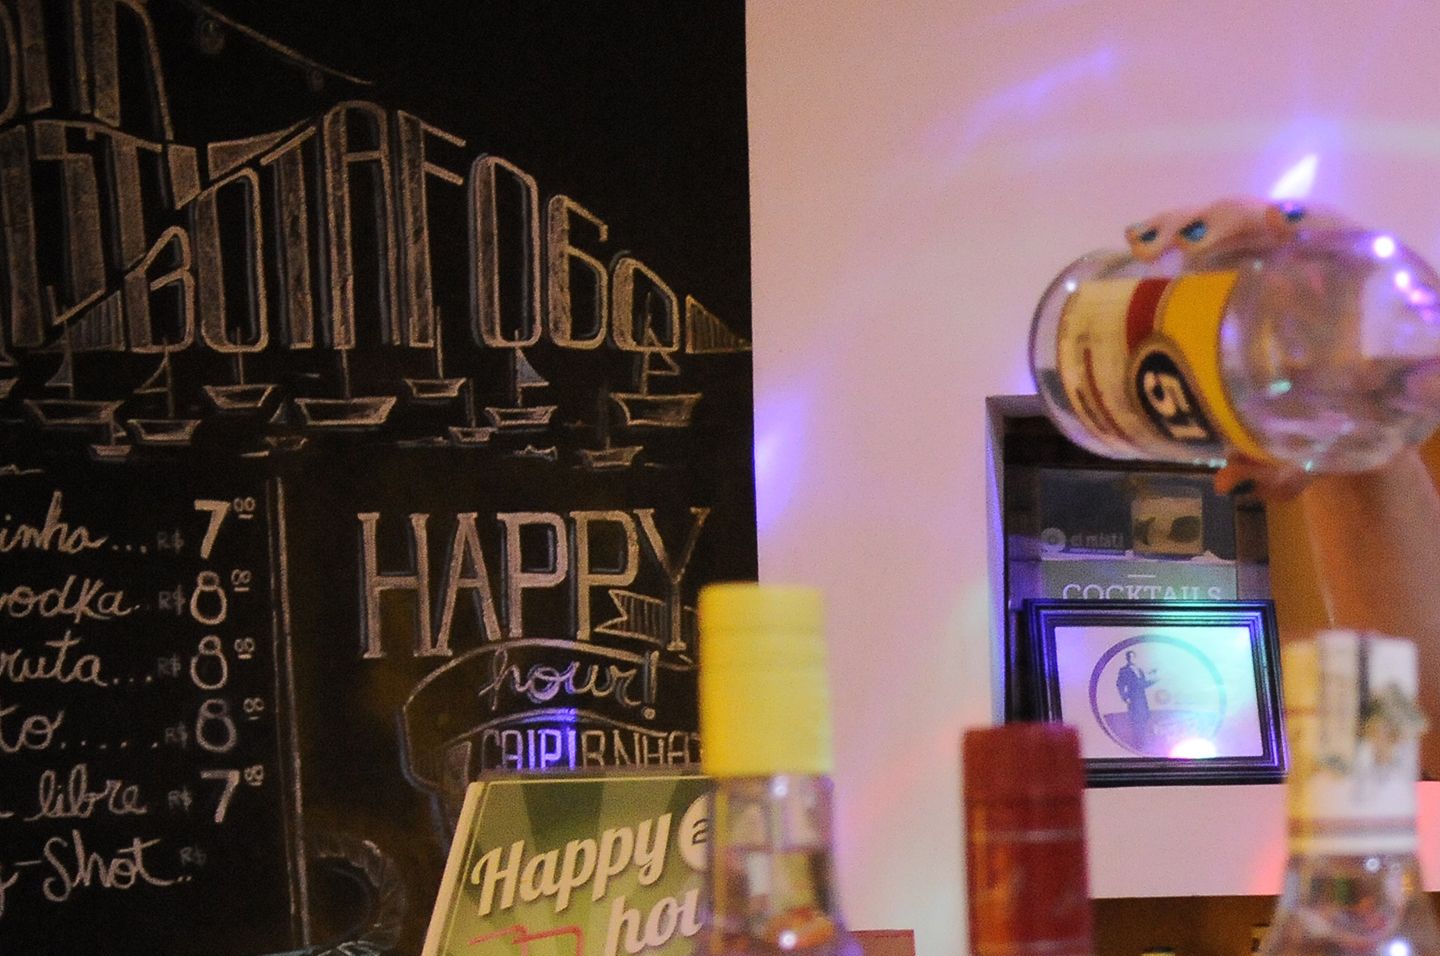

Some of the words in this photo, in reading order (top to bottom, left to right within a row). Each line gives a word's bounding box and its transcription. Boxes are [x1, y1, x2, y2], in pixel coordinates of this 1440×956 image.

[1143, 370, 1207, 439] 51
[357, 507, 711, 659] HAPPY
[1063, 583, 1222, 601] COCKTAILS
[24, 762, 148, 821] libre
[470, 813, 673, 917] Happy
